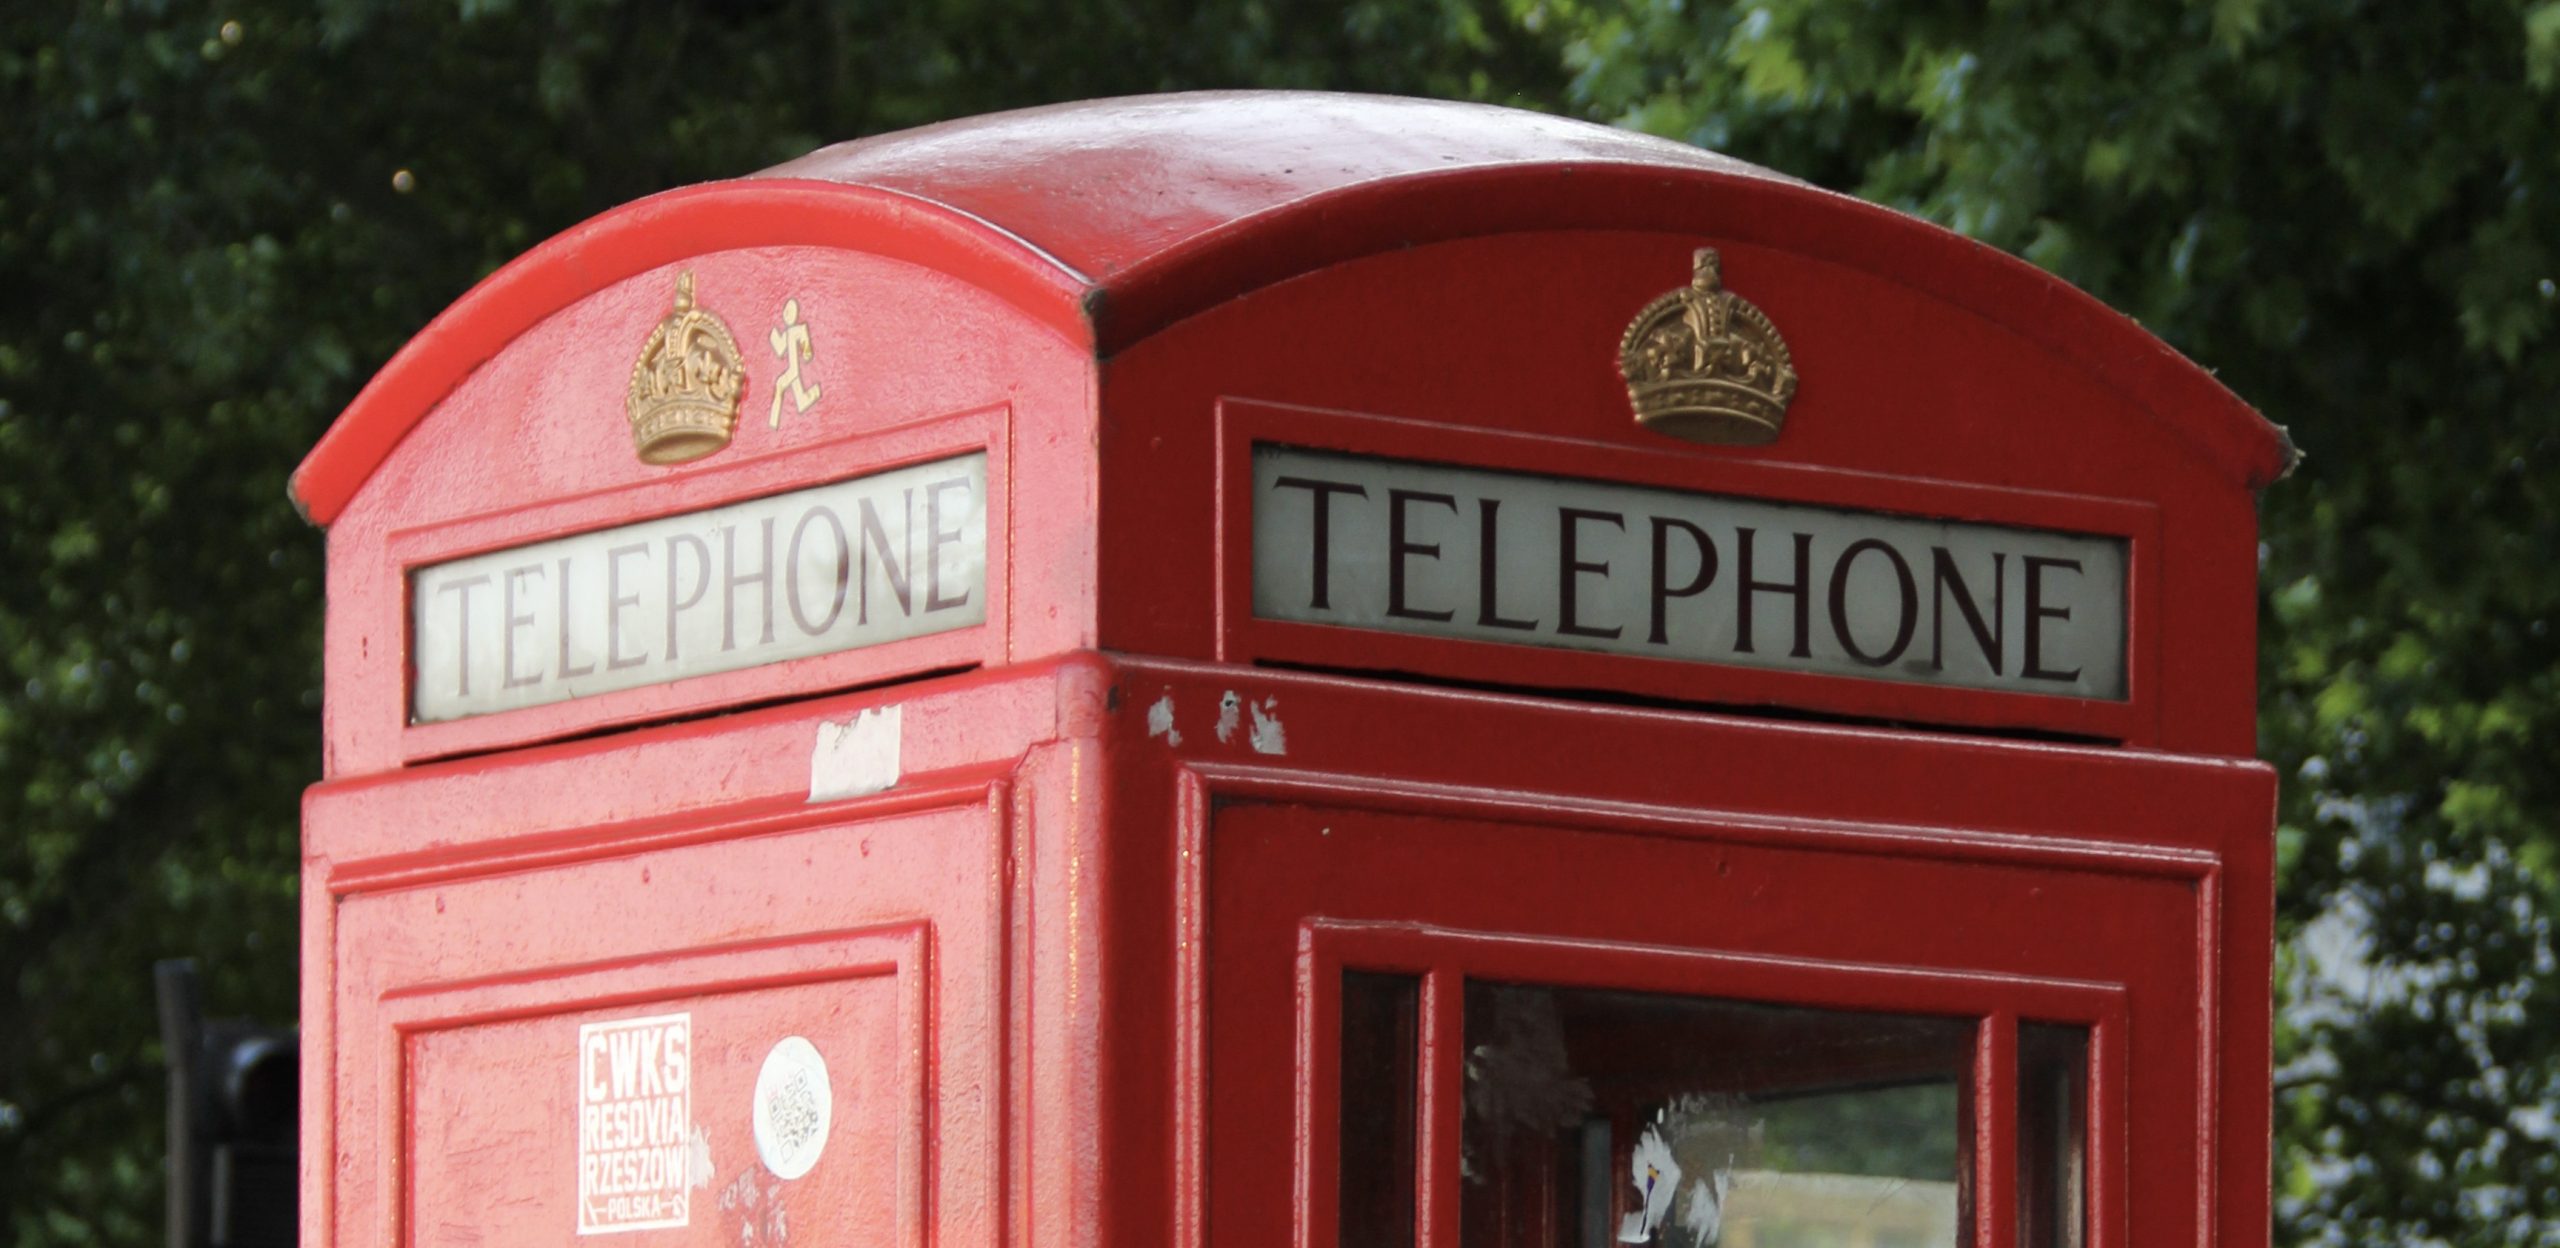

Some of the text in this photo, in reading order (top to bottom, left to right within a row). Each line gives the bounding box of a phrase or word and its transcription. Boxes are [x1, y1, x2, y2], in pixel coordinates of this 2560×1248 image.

[437, 476, 971, 697] TELEPHONE
[1273, 476, 2083, 682] TELEPHONE
[587, 1026, 685, 1102] CWKS
[586, 1096, 684, 1149] RESOVIA
[608, 1195, 661, 1221] POLSKA
